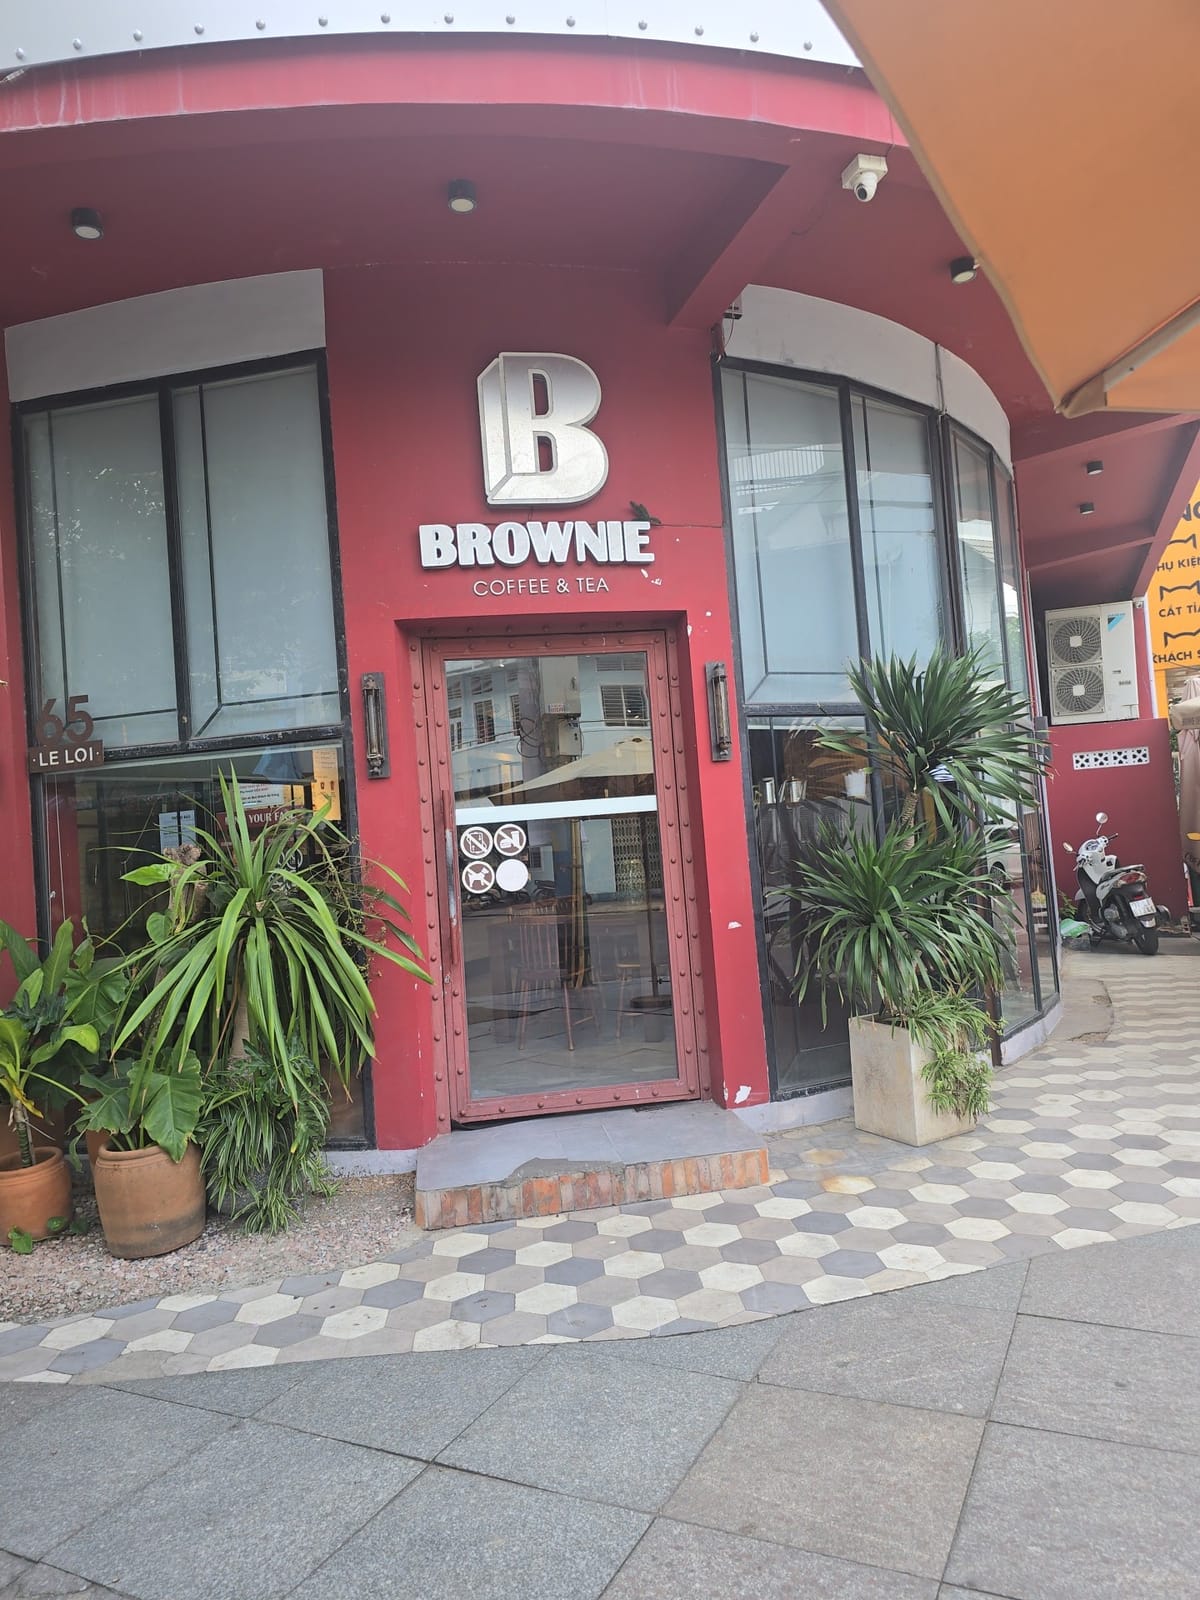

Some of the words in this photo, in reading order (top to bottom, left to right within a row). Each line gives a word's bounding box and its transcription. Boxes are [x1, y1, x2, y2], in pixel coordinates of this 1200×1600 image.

[477, 352, 609, 505] B
[419, 521, 655, 567] BROWNIE
[1157, 561, 1174, 573] HỤ
[1178, 556, 1200, 569] KIỆ
[473, 578, 549, 596] COFFEE
[556, 577, 570, 593] &
[576, 577, 609, 593] TEA
[36, 694, 94, 744] 65
[39, 750, 60, 767] LE
[64, 746, 94, 763] LOI
[248, 812, 272, 824] YOUR
